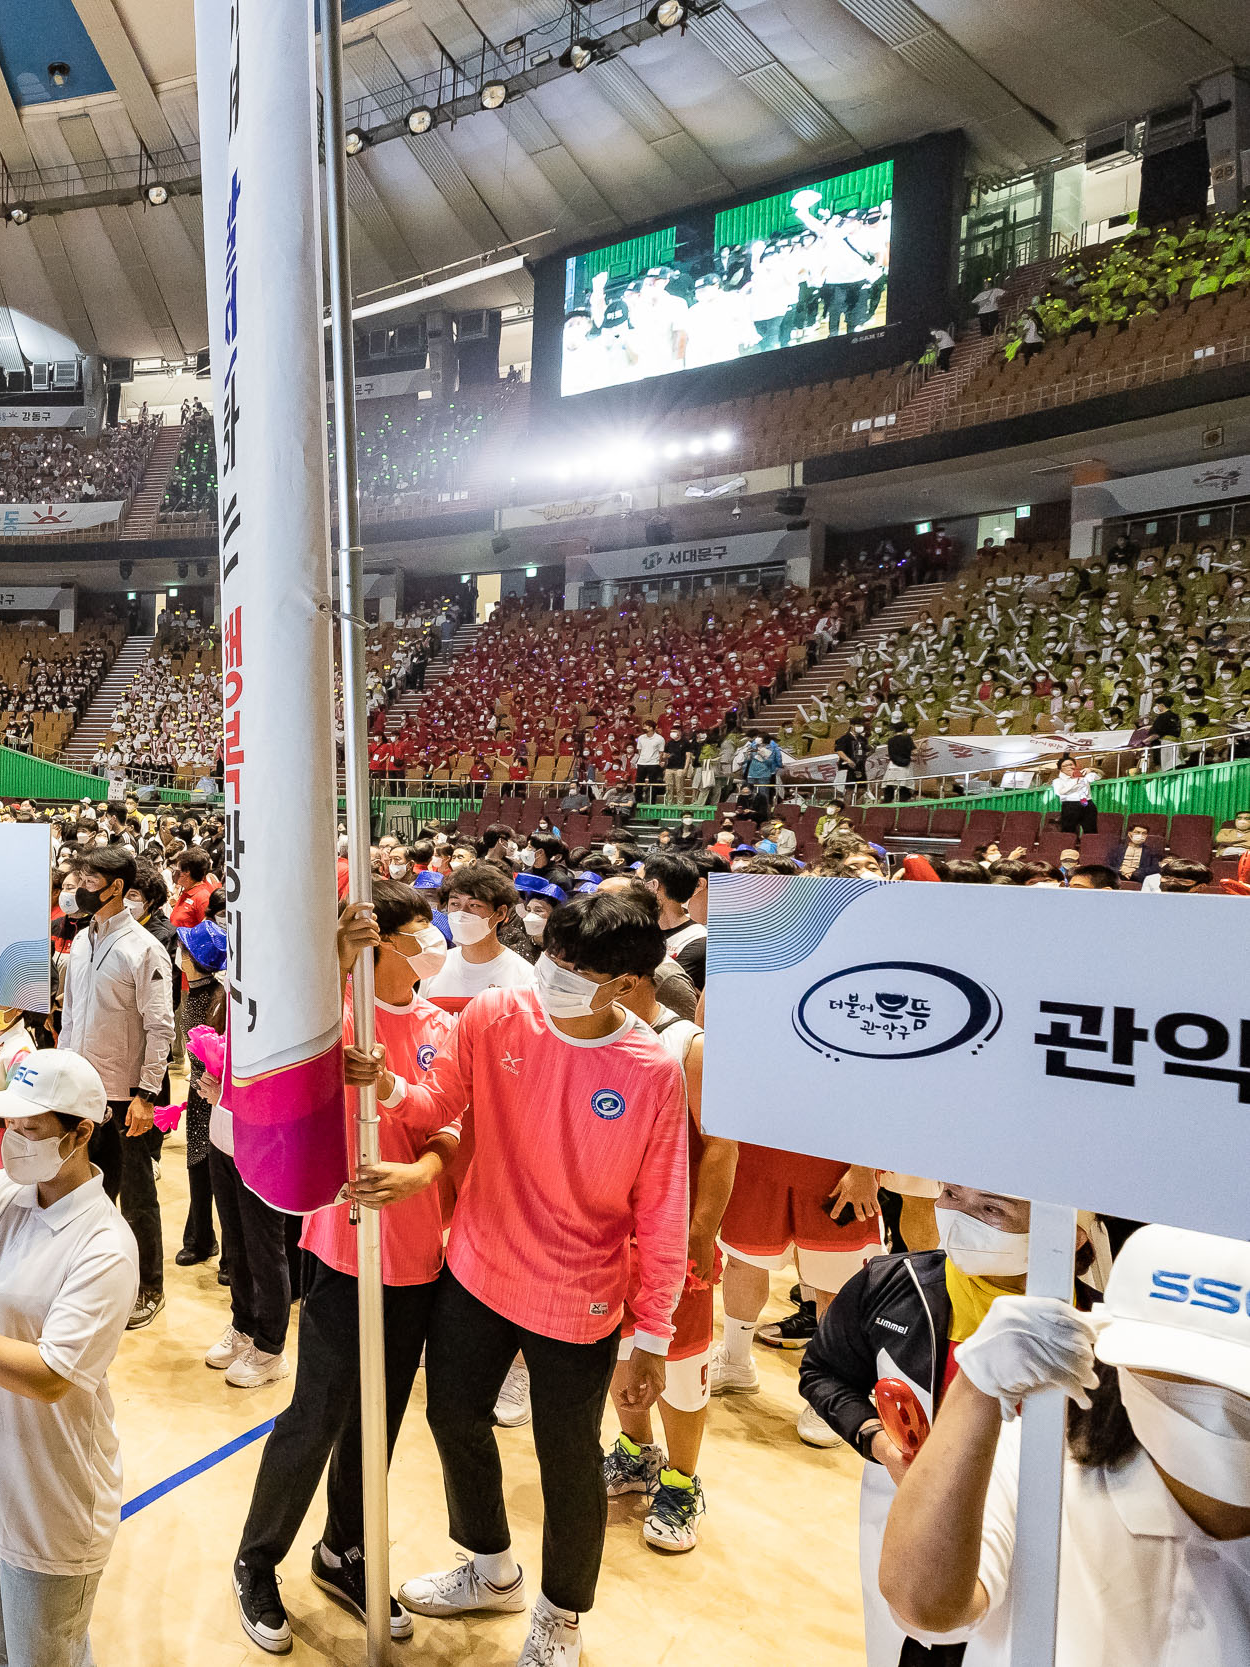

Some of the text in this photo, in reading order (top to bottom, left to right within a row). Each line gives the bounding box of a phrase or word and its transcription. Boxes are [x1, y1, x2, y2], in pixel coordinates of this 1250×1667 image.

[21, 411, 51, 421] 강동구
[668, 545, 728, 564] 서대문구
[829, 993, 874, 1019] 더불어
[859, 1020, 911, 1041] 관악구
[1150, 1269, 1250, 1319] SS
